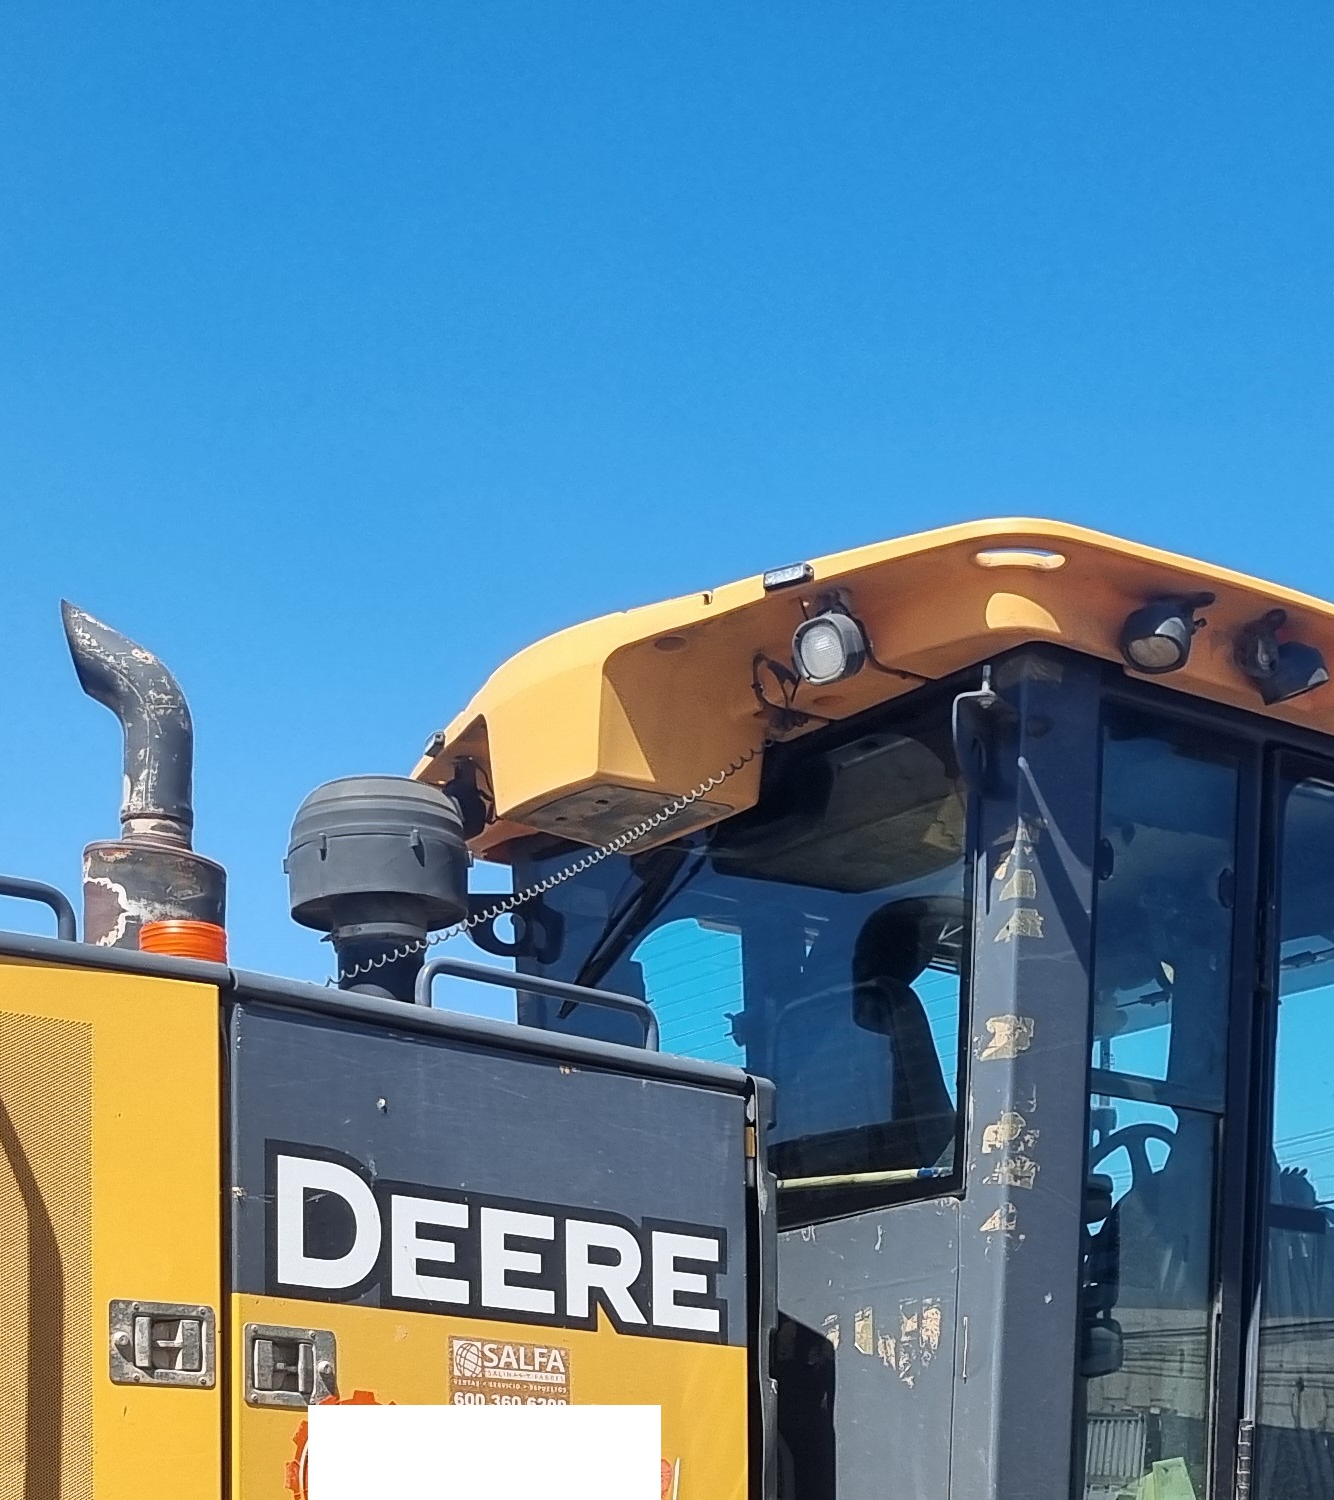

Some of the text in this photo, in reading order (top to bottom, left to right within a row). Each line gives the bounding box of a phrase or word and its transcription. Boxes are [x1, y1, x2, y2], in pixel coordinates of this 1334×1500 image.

[276, 1154, 720, 1333] DEERE
[483, 1343, 565, 1373] SALFA
[453, 1378, 480, 1387] VENTAS
[489, 1381, 521, 1390] SERVICIO
[534, 1374, 564, 1382] FABRES
